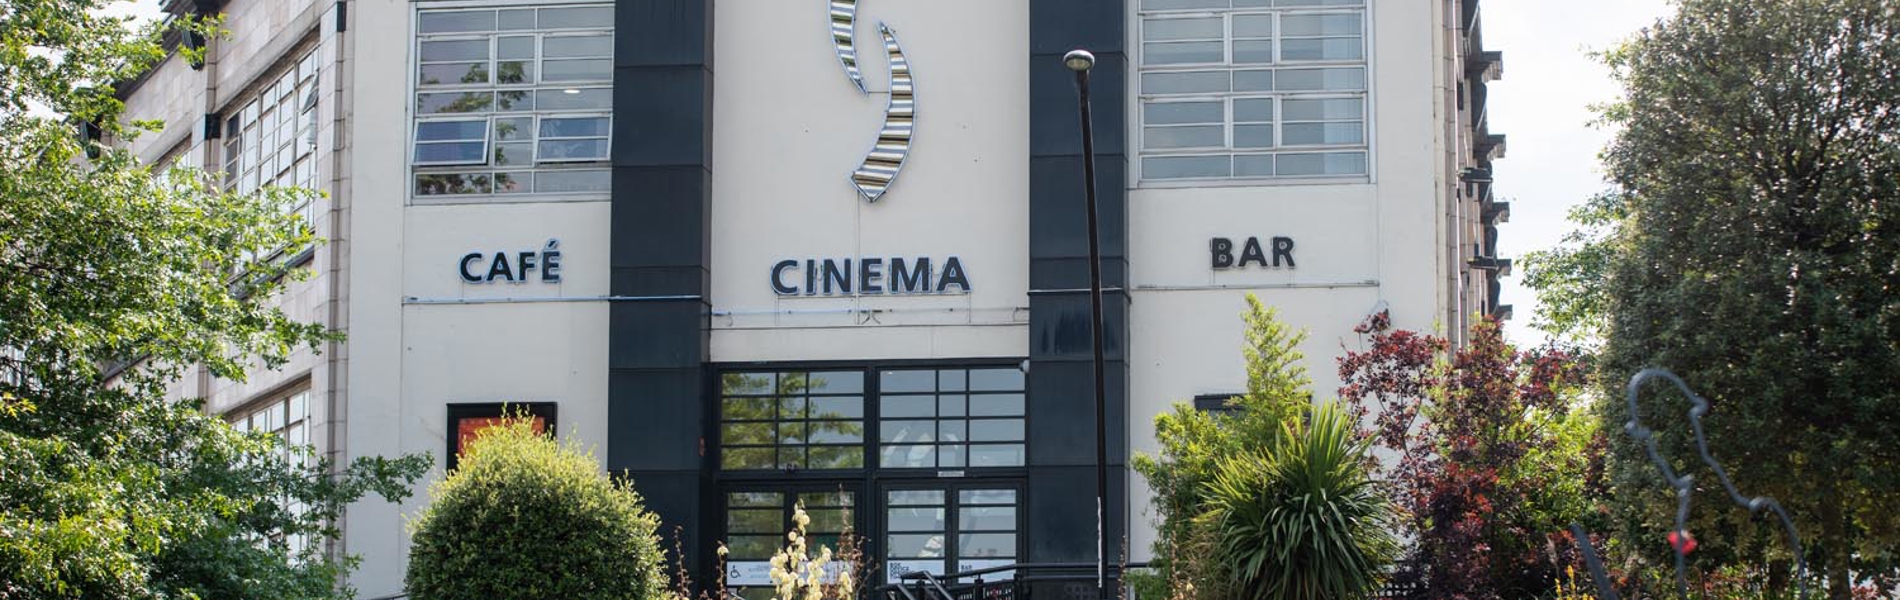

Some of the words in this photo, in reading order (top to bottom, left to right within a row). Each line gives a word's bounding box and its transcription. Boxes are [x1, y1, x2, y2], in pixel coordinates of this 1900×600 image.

[459, 239, 561, 283] CAFÉ
[1210, 236, 1296, 269] BAR
[771, 256, 971, 295] CINEMA
